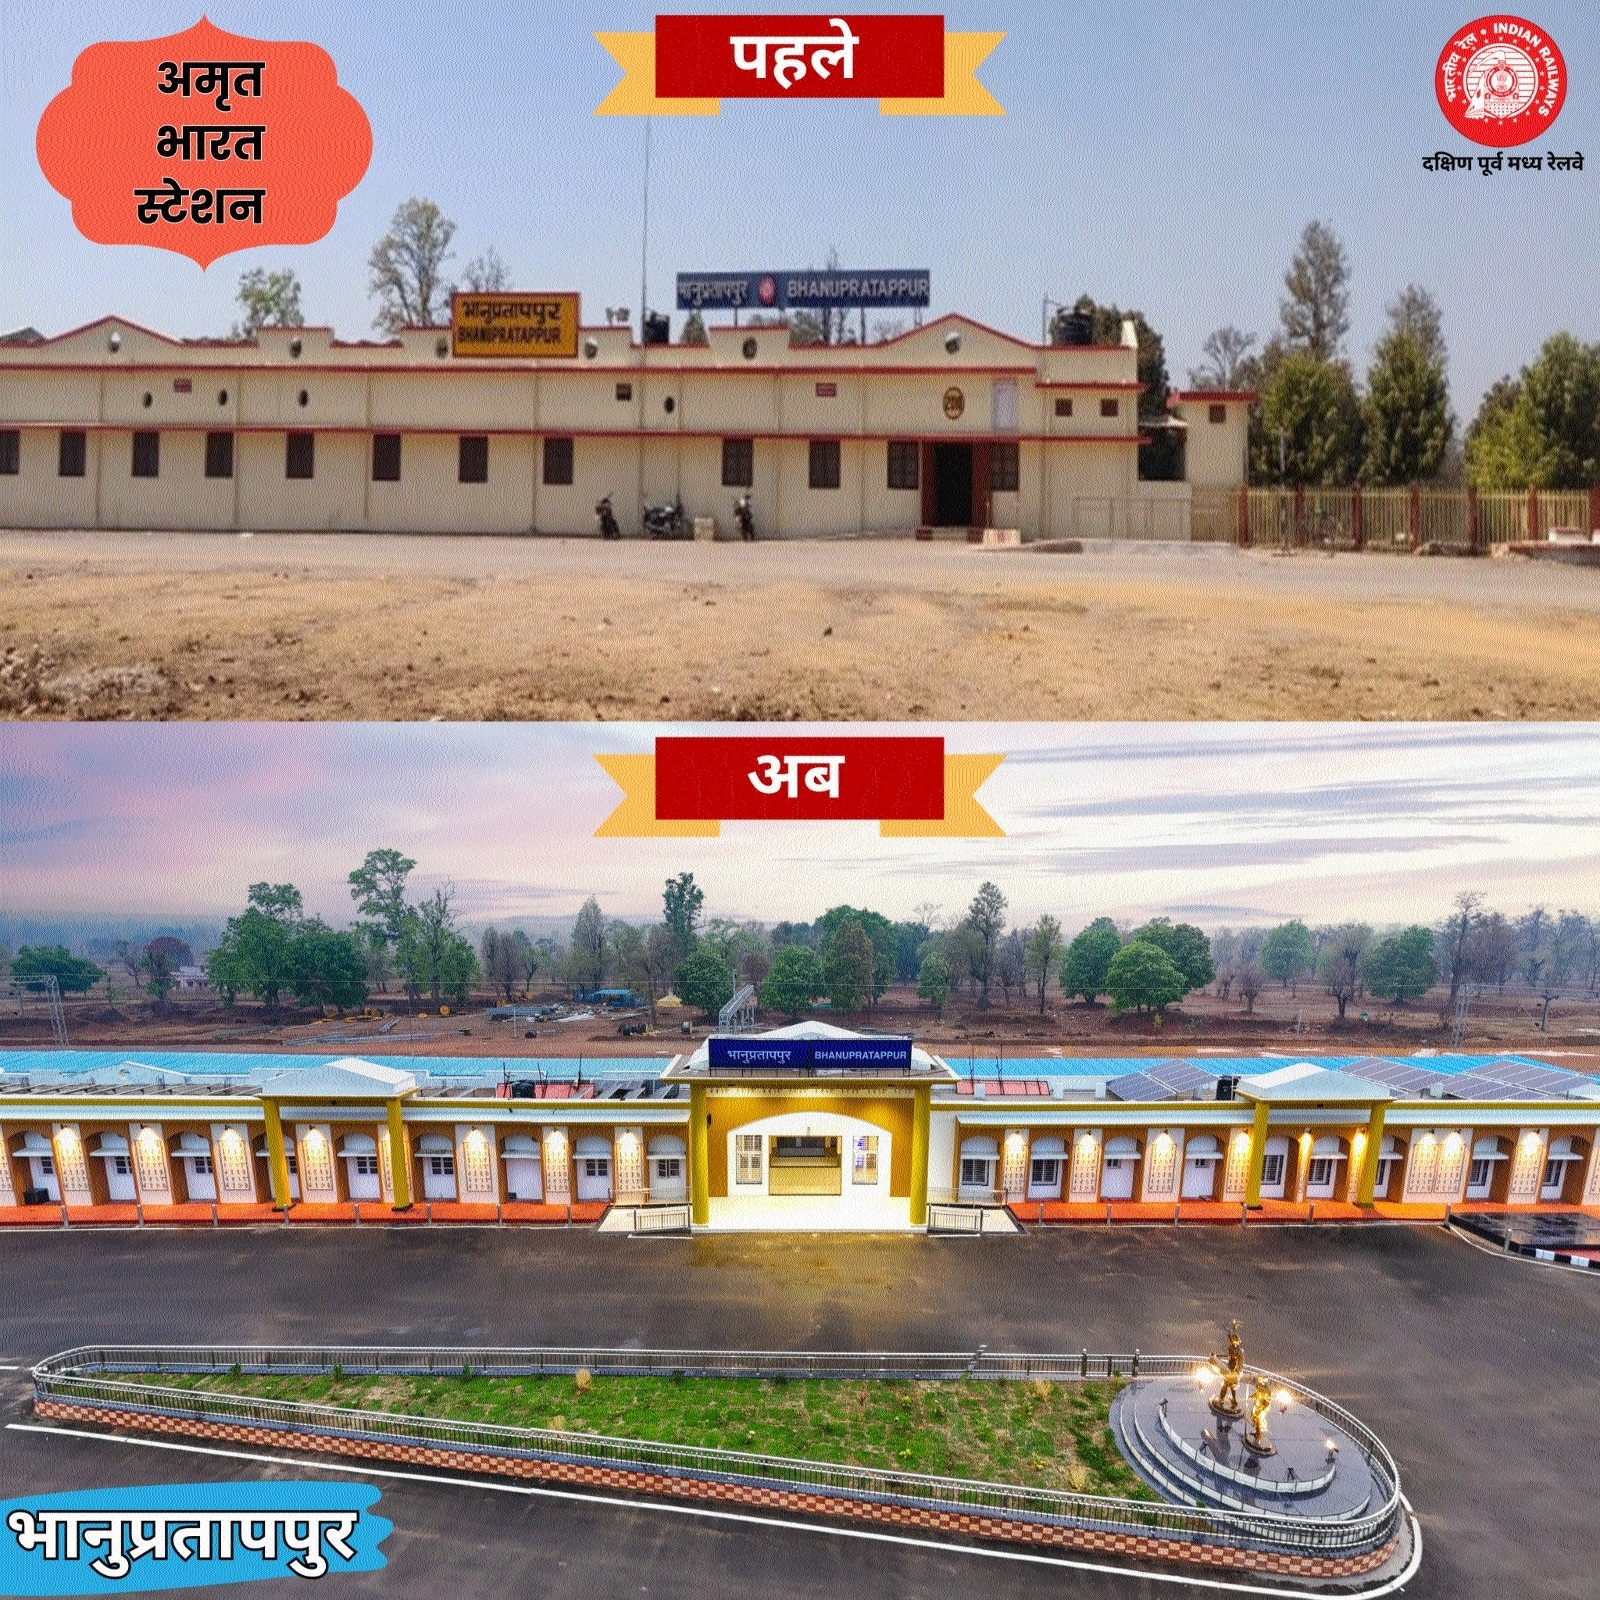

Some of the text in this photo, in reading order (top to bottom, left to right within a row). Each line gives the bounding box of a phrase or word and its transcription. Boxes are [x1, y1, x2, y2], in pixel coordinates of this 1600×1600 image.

[787, 278, 929, 299] BHANUPRATAPPUR
[727, 1050, 792, 1064] भानुप्रतापपुर
[814, 1051, 907, 1060] BHANUPRATAPPUR
